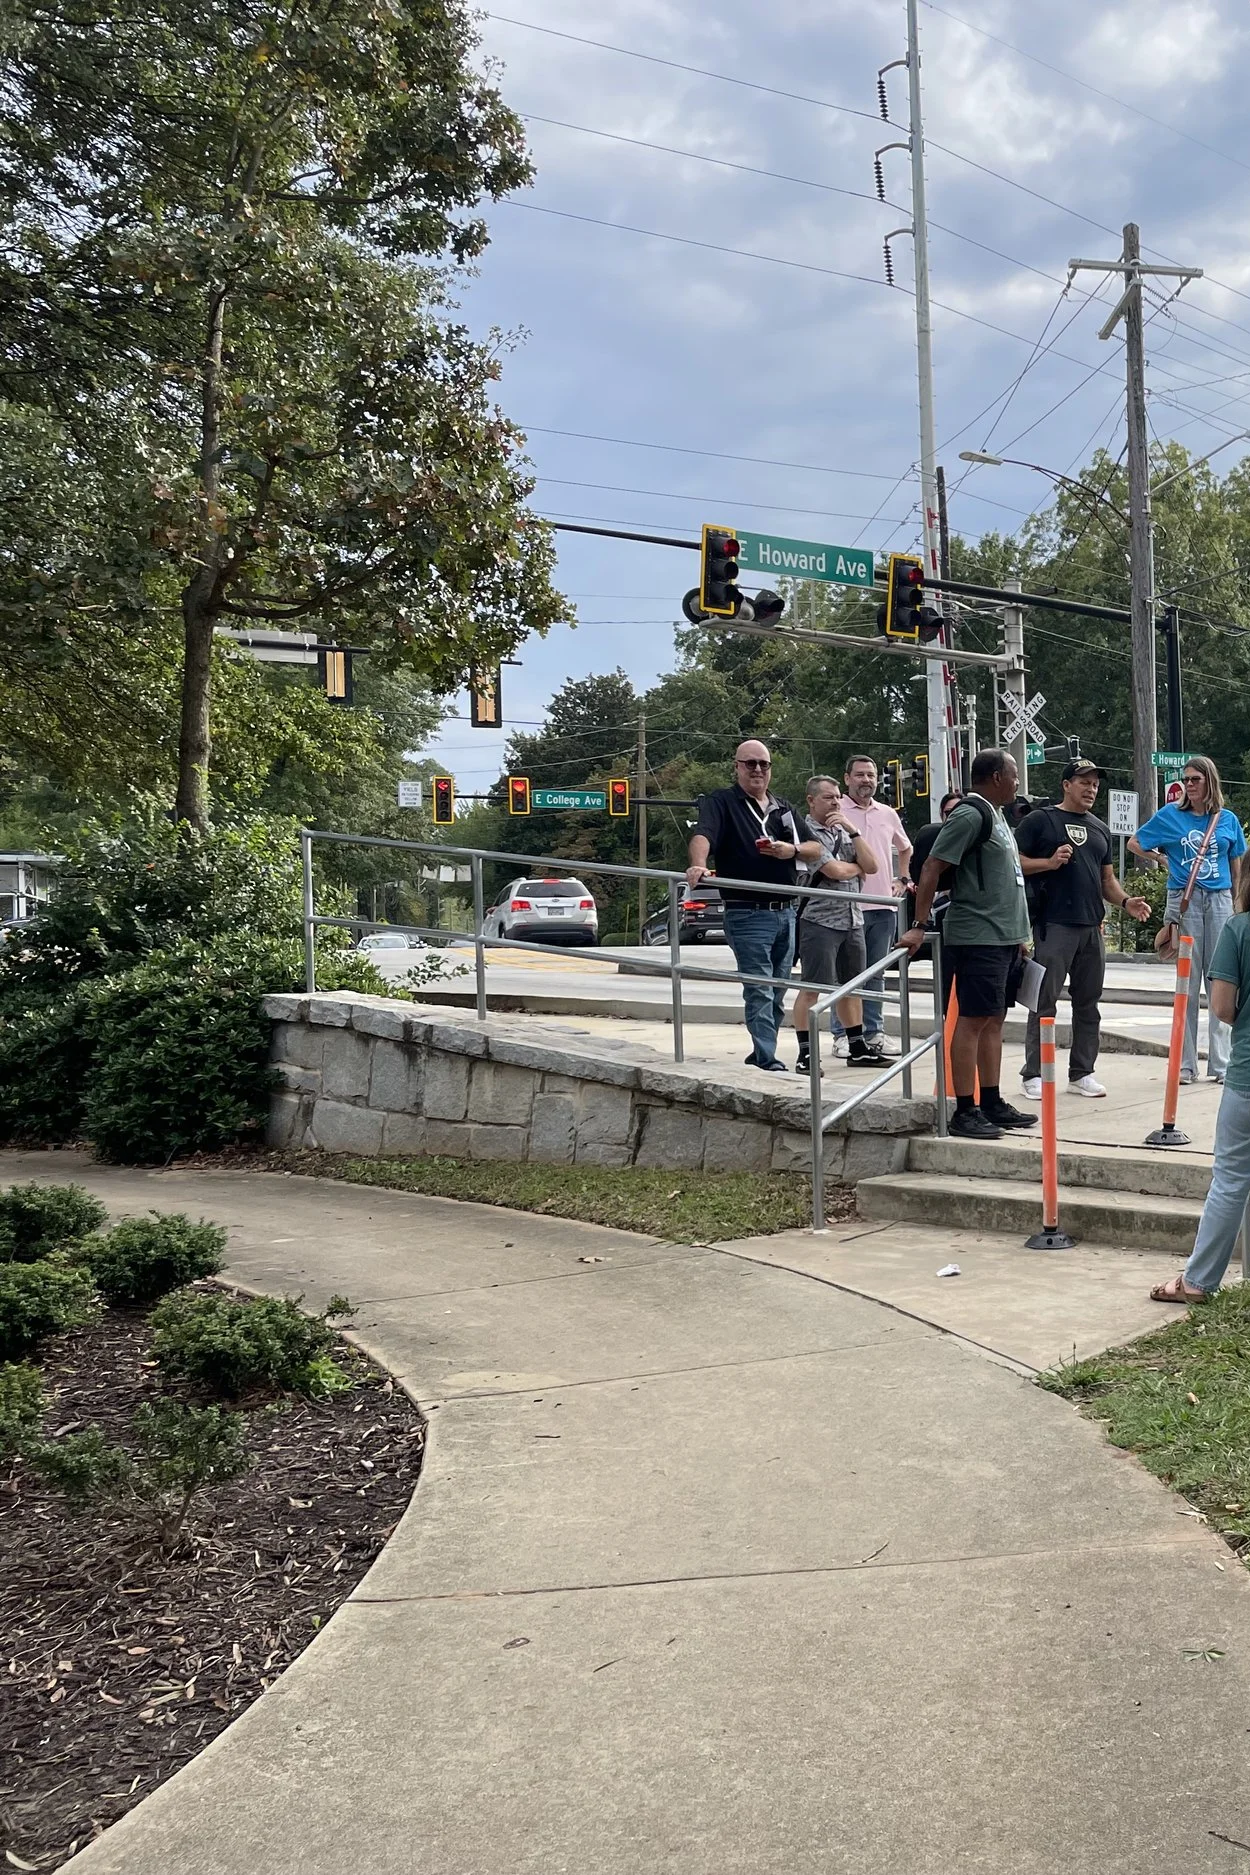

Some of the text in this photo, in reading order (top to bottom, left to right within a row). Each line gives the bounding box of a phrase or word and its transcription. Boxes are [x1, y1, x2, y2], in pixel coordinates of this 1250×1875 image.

[738, 540, 867, 578] E Howard Ave
[1005, 696, 1044, 740] CROSSING
[1026, 719, 1044, 743] ROAD
[1151, 753, 1157, 765] E
[1158, 754, 1185, 766] Howard
[535, 794, 602, 807] E College Ave
[1113, 793, 1134, 803] DO NOT
[1117, 804, 1130, 812] STOP
[1120, 814, 1127, 822] ON
[1113, 822, 1134, 833] TRACKS
